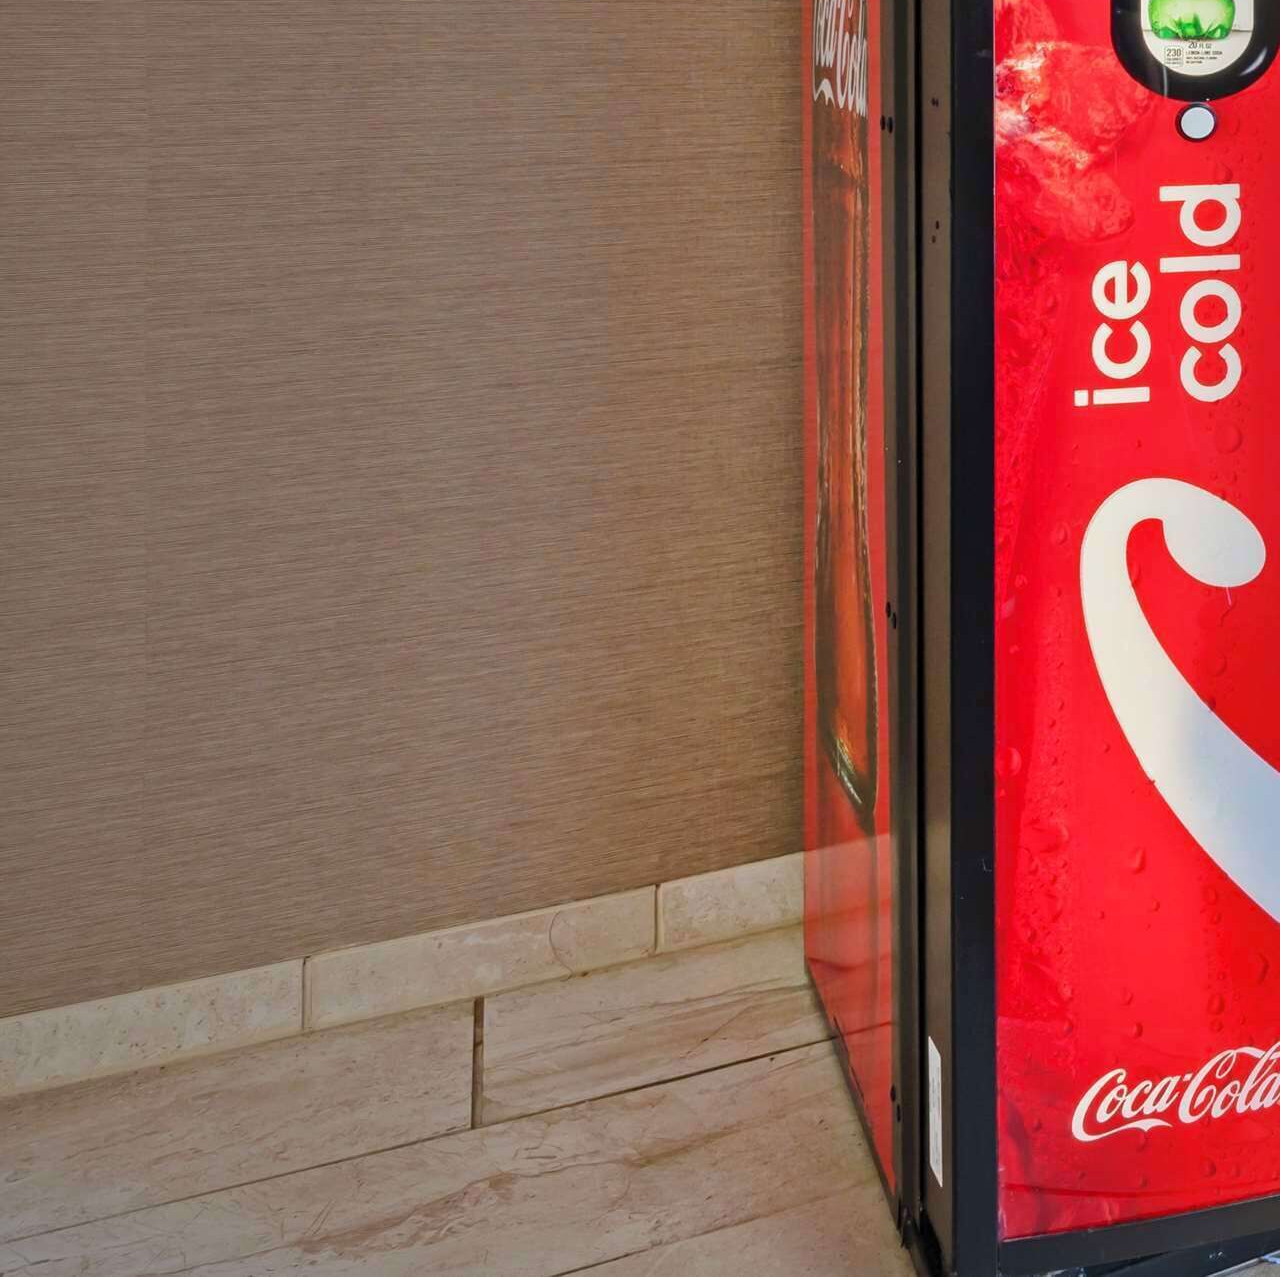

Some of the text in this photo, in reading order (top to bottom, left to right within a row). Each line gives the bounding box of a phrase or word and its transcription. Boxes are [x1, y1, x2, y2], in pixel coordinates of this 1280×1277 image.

[1166, 48, 1182, 58] 230
[1188, 41, 1198, 49] 20
[1159, 183, 1242, 403] cold
[1074, 260, 1151, 406] ice
